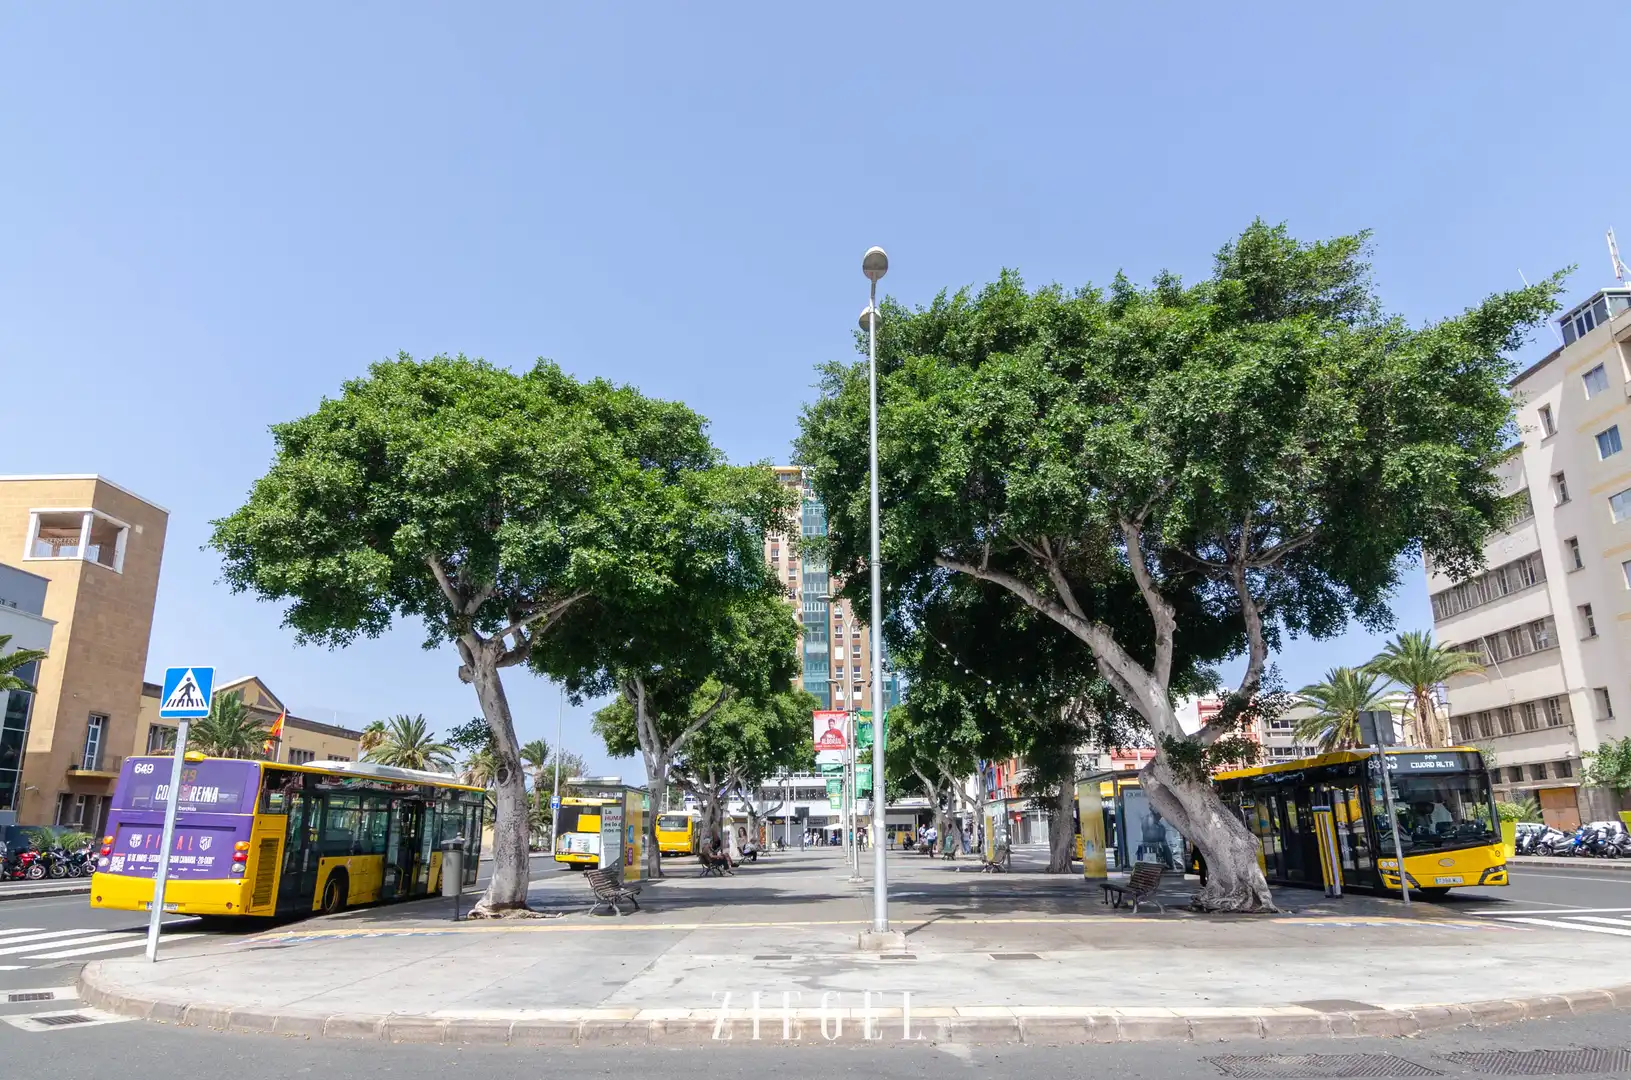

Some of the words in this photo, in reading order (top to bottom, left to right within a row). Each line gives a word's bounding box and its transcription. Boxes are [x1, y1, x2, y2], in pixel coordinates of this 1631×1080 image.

[134, 763, 154, 774] 649
[189, 786, 219, 803] REINA
[145, 834, 194, 851] FIAL
